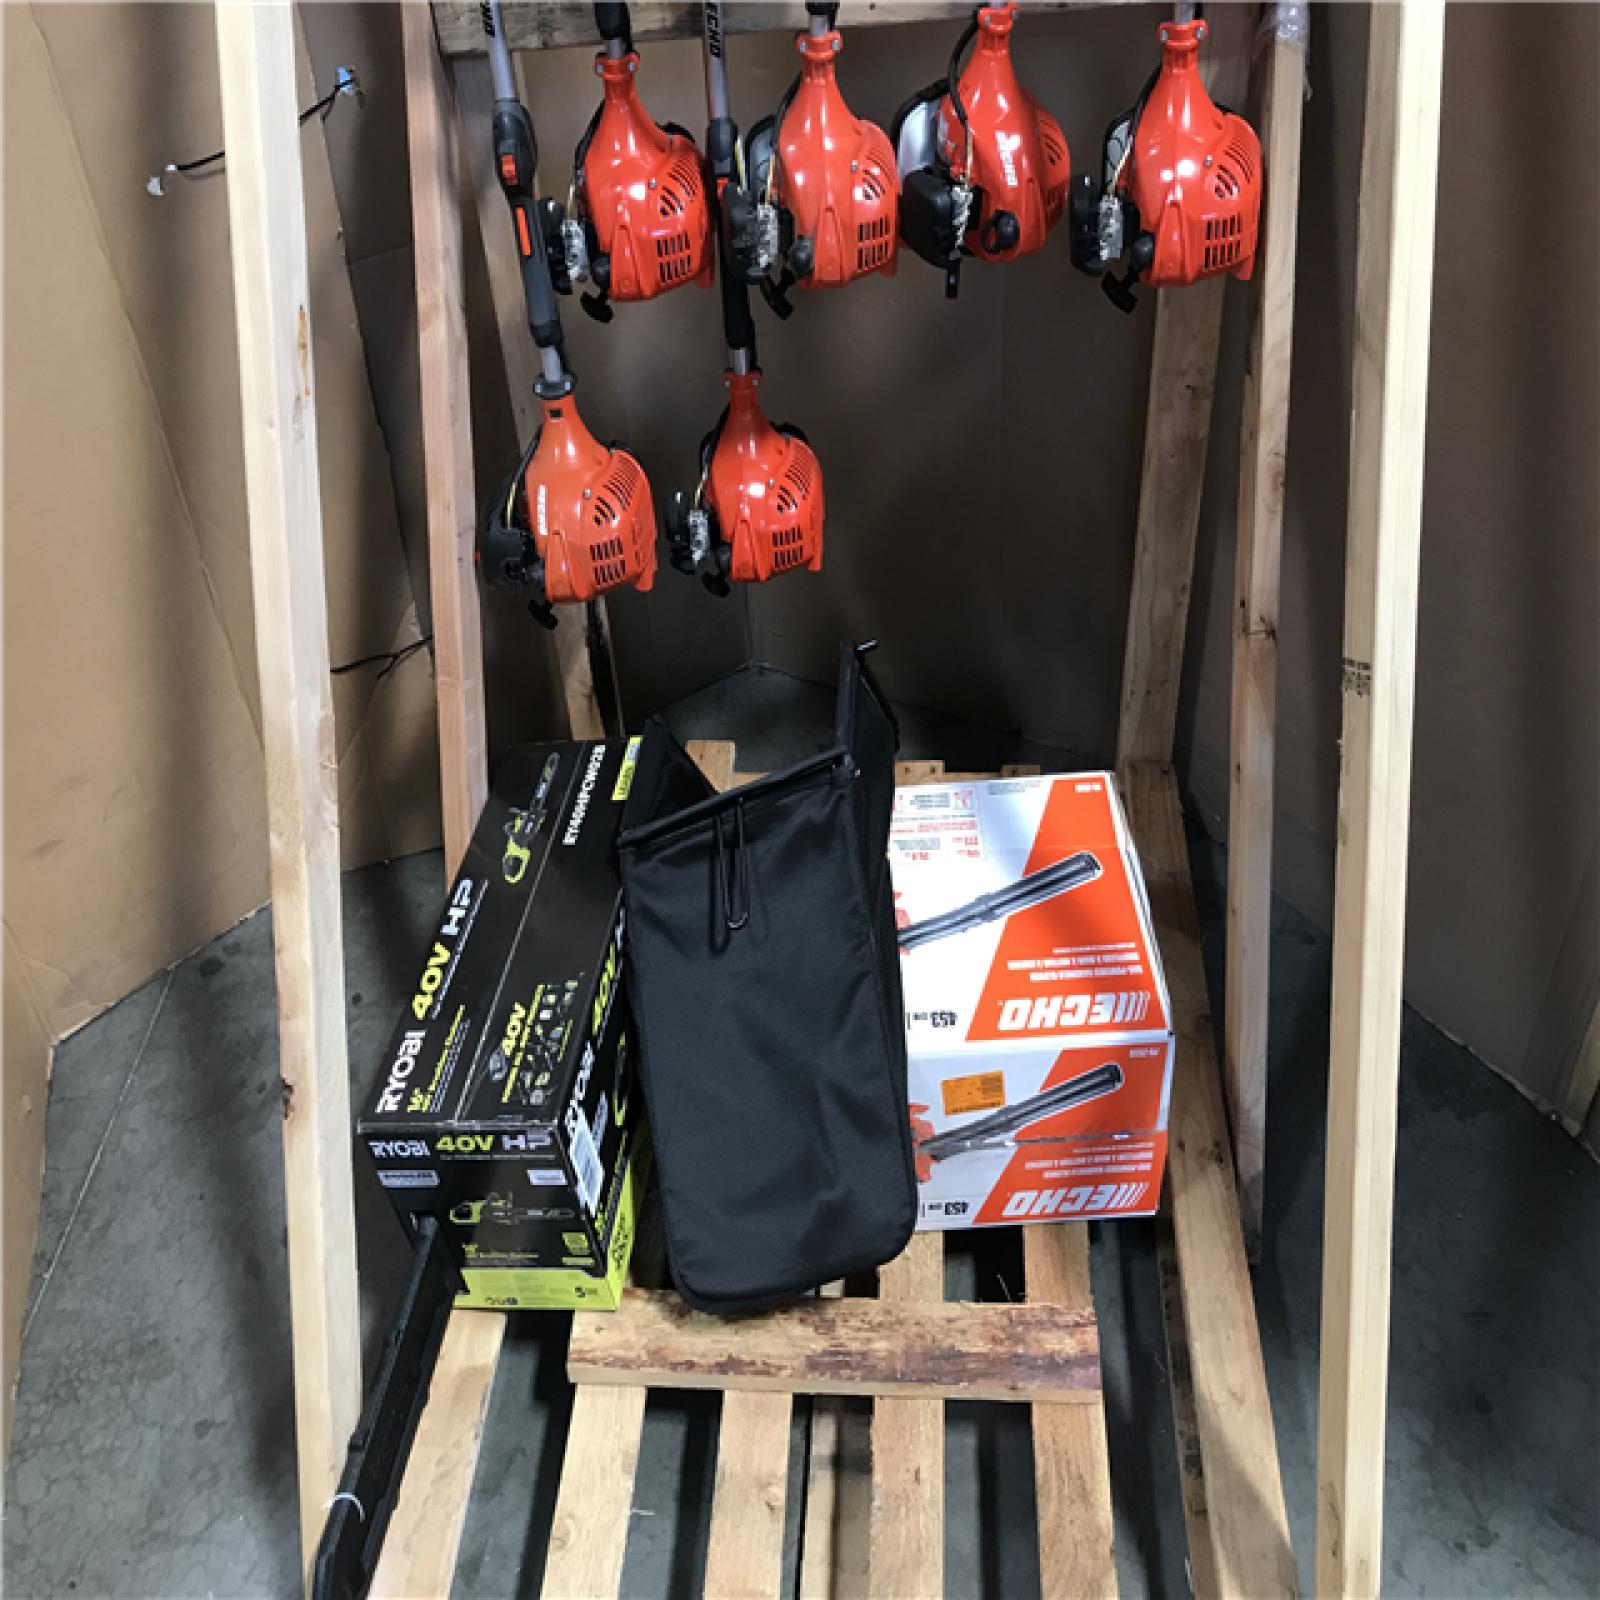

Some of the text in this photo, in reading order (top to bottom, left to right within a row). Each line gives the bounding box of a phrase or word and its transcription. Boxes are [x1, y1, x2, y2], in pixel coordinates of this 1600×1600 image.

[375, 1030, 427, 1113] RYOBI
[412, 942, 450, 1020] 40V
[441, 878, 473, 935] HP
[998, 993, 1118, 1031] ECHO
[502, 1002, 525, 1057] 40V
[368, 1129, 552, 1159] RYOBI 40V HP
[1002, 1183, 1120, 1216] ECHO
